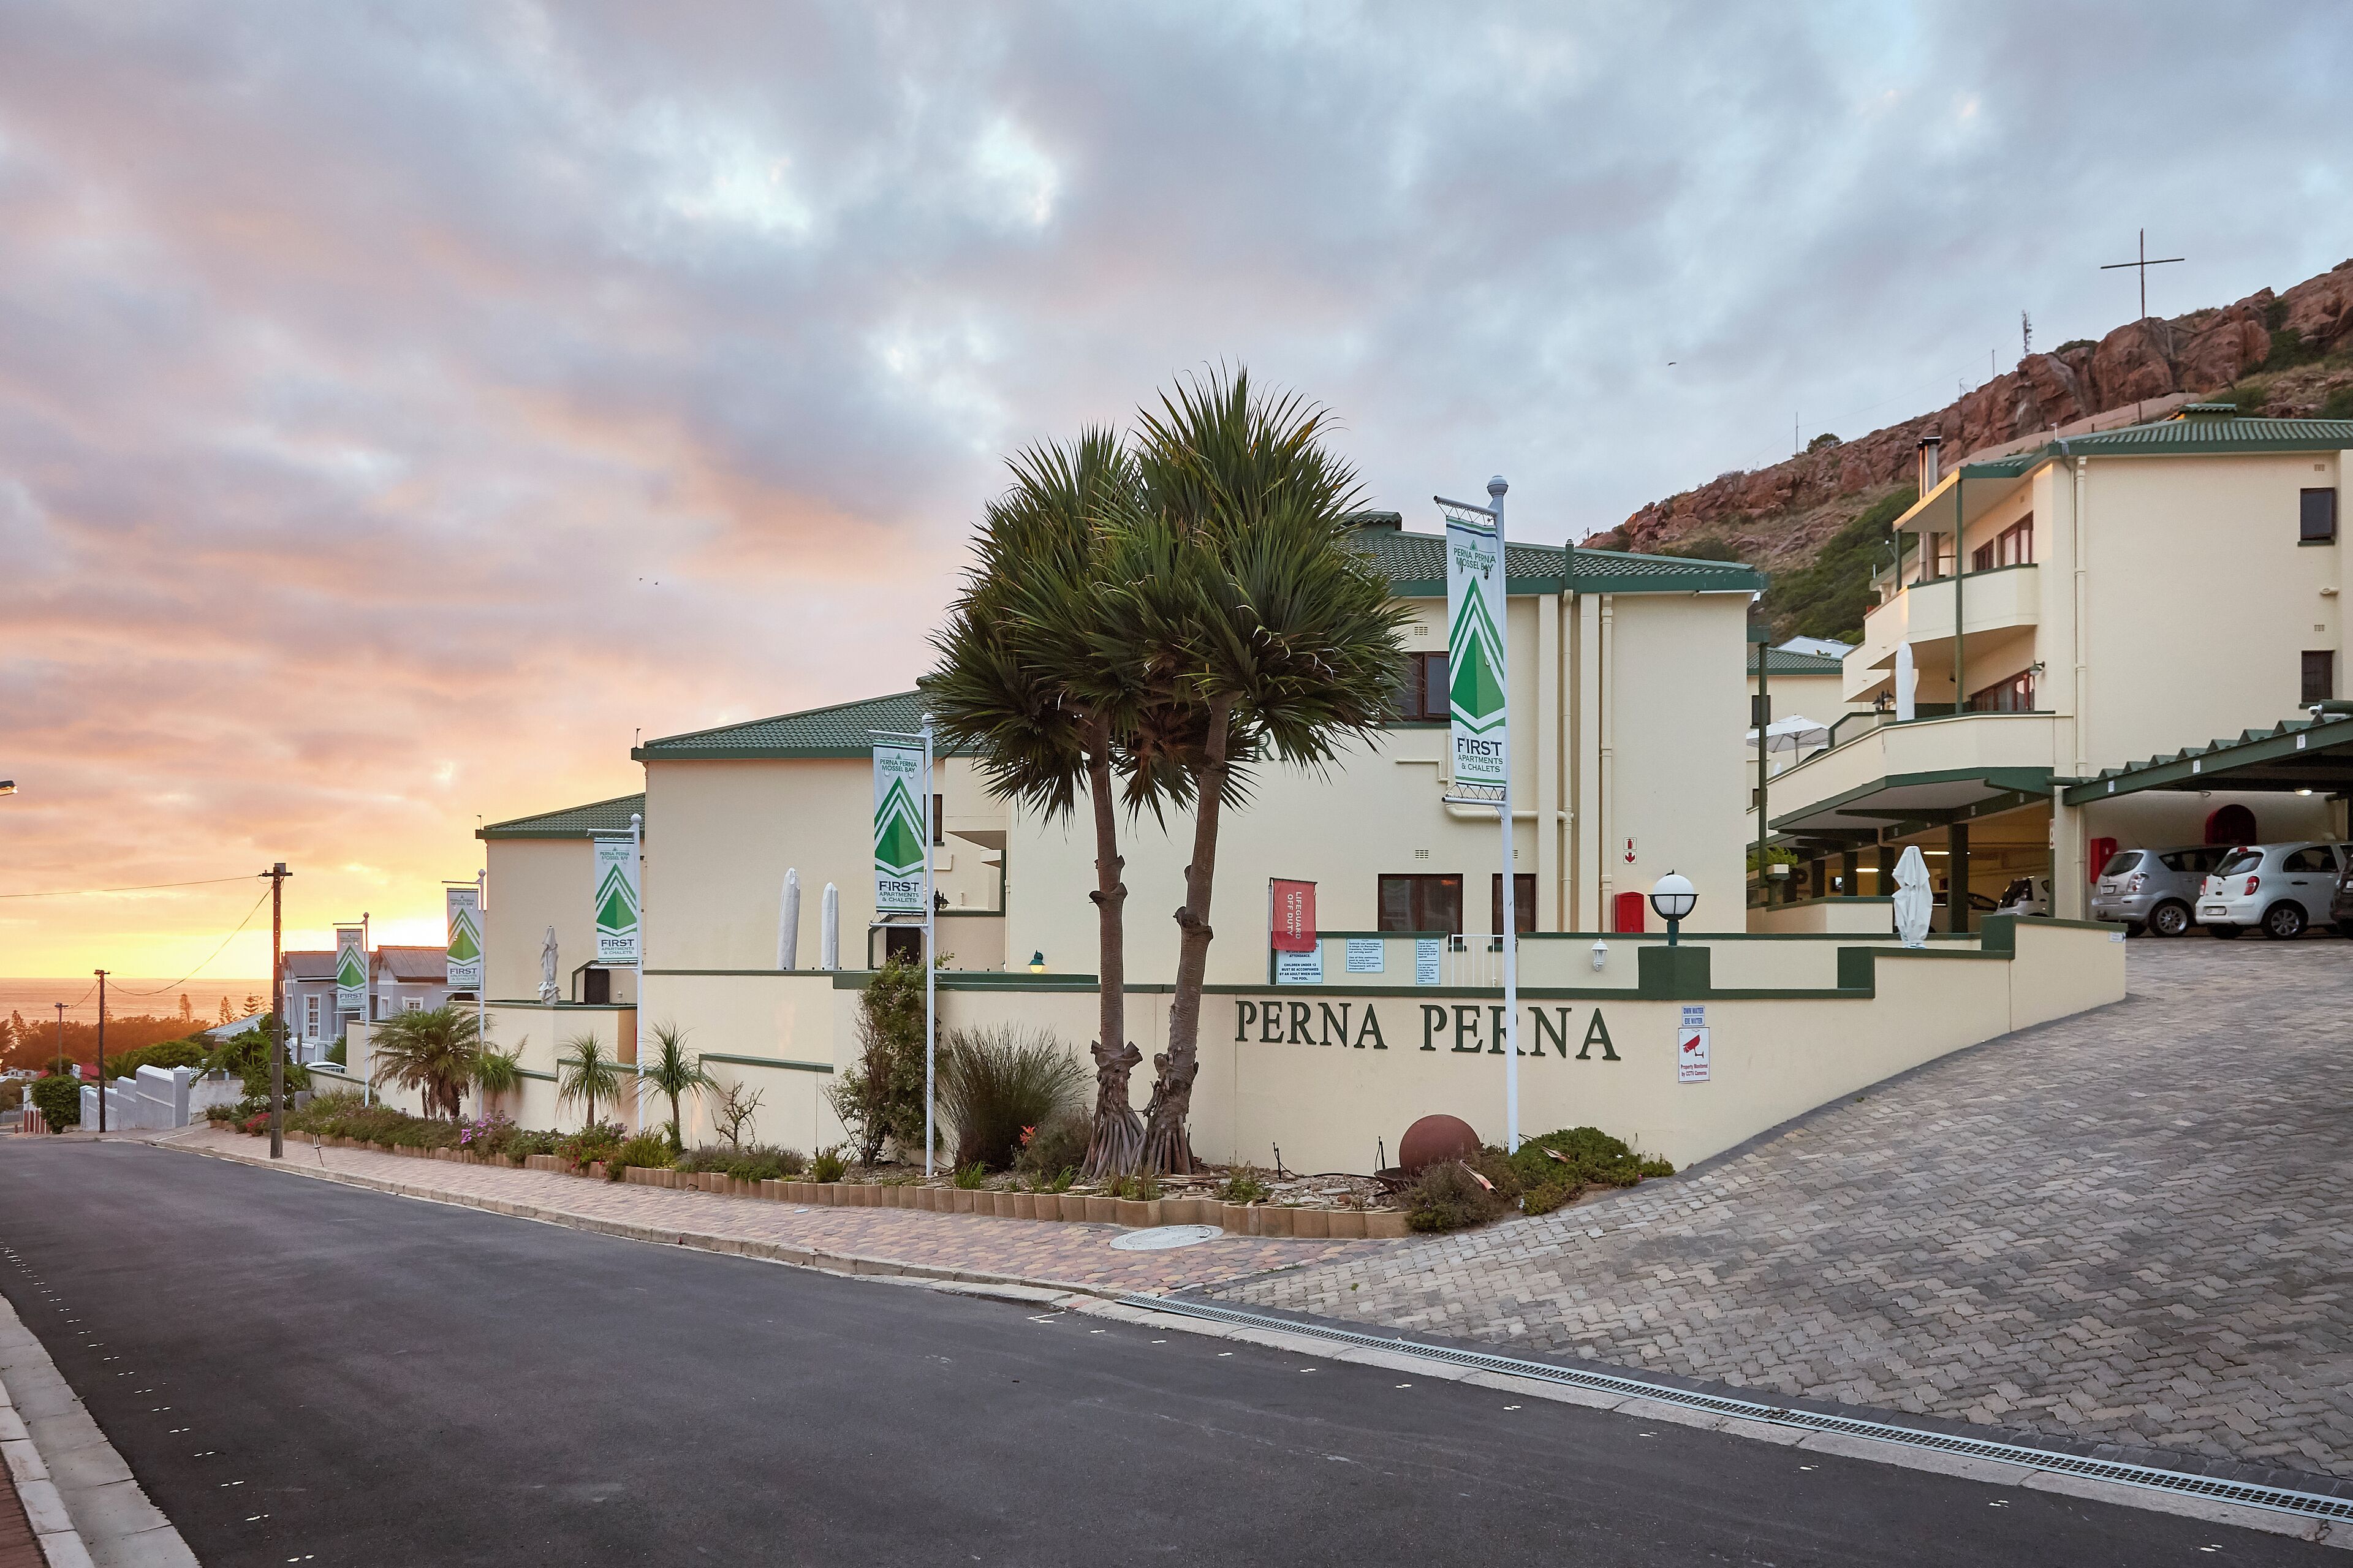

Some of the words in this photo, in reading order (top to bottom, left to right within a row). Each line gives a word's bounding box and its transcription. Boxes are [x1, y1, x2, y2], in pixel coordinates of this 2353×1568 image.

[1453, 547, 1472, 559] PERNA
[1475, 552, 1496, 563] PERNA
[1456, 557, 1479, 570] MOSSEL
[1457, 737, 1502, 756] FIRST
[1458, 754, 1503, 764] APARTMENTS
[1468, 763, 1501, 773] CHALETS
[879, 881, 919, 892] FIRST
[1235, 1001, 1389, 1050] PERNA
[1419, 1004, 1621, 1061] PERNA
